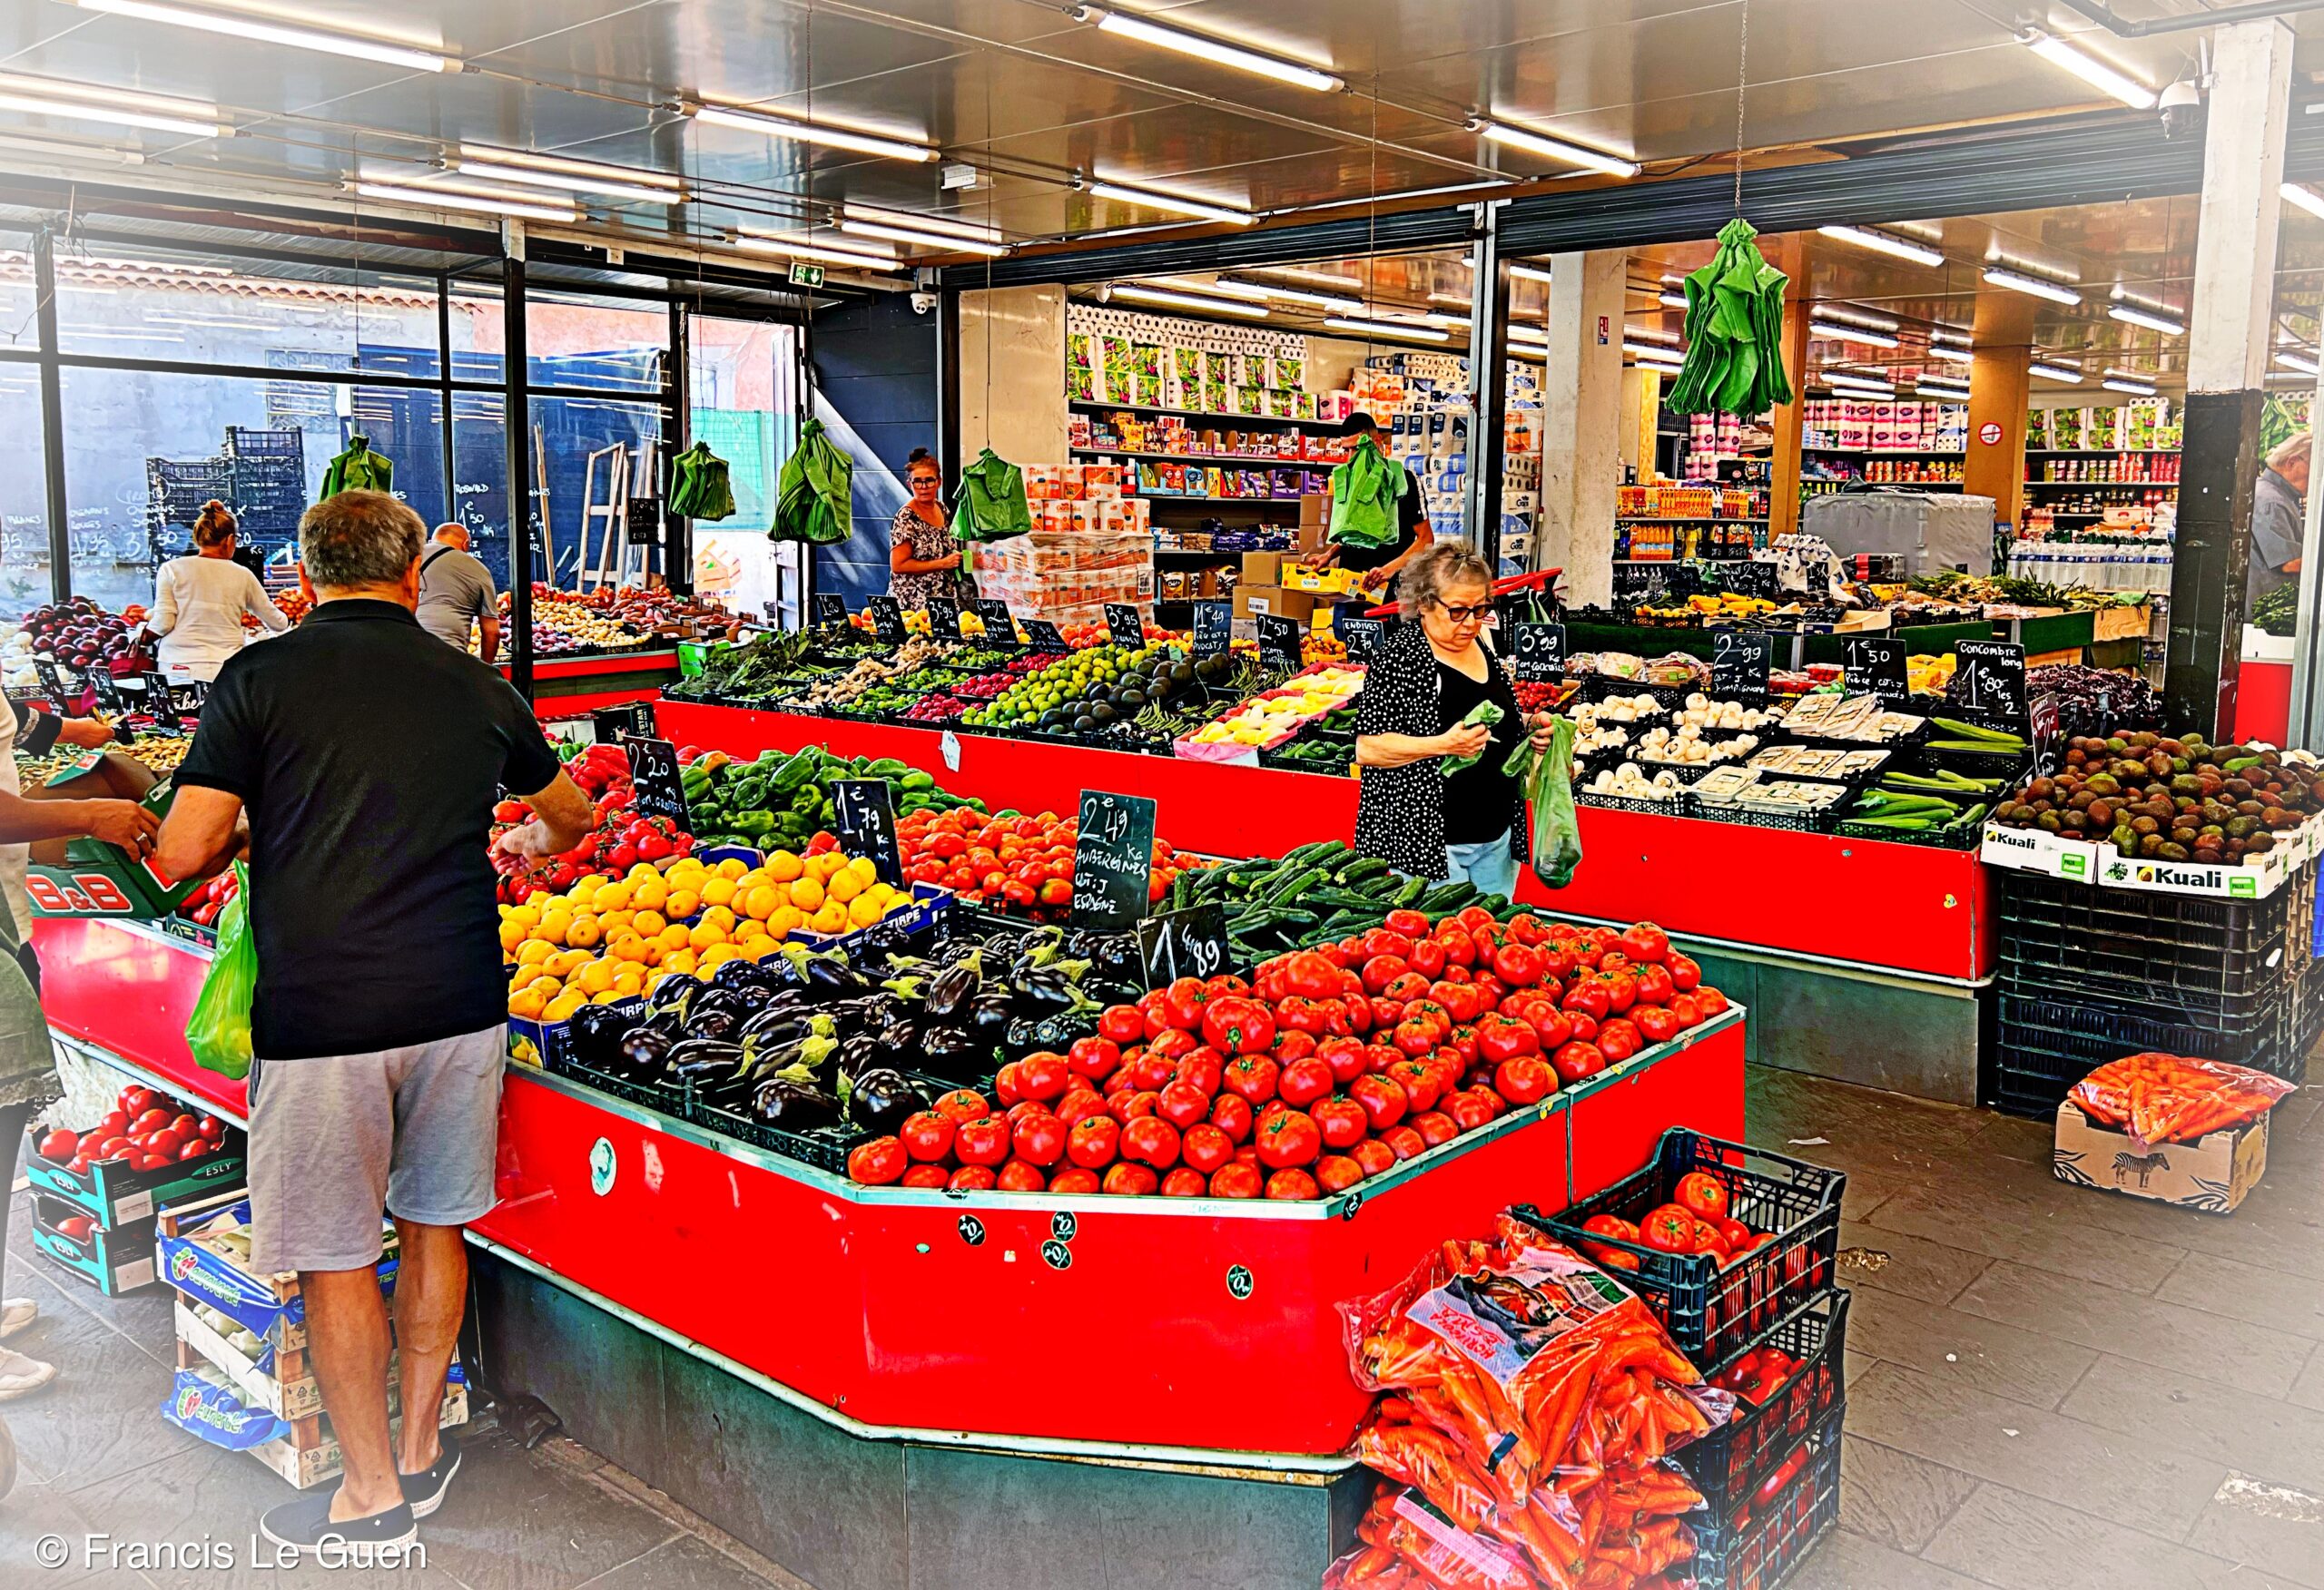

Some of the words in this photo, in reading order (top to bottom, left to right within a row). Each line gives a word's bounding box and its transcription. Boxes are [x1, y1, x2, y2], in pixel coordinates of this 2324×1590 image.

[1344, 622, 1380, 632] ENDIVES
[1996, 831, 2036, 850] Kuali
[2155, 868, 2221, 888] Kuali
[25, 873, 133, 913] B&B
[205, 1163, 231, 1177] ESLY
[54, 1173, 74, 1191] ESLY
[54, 1239, 74, 1257] ESLY
